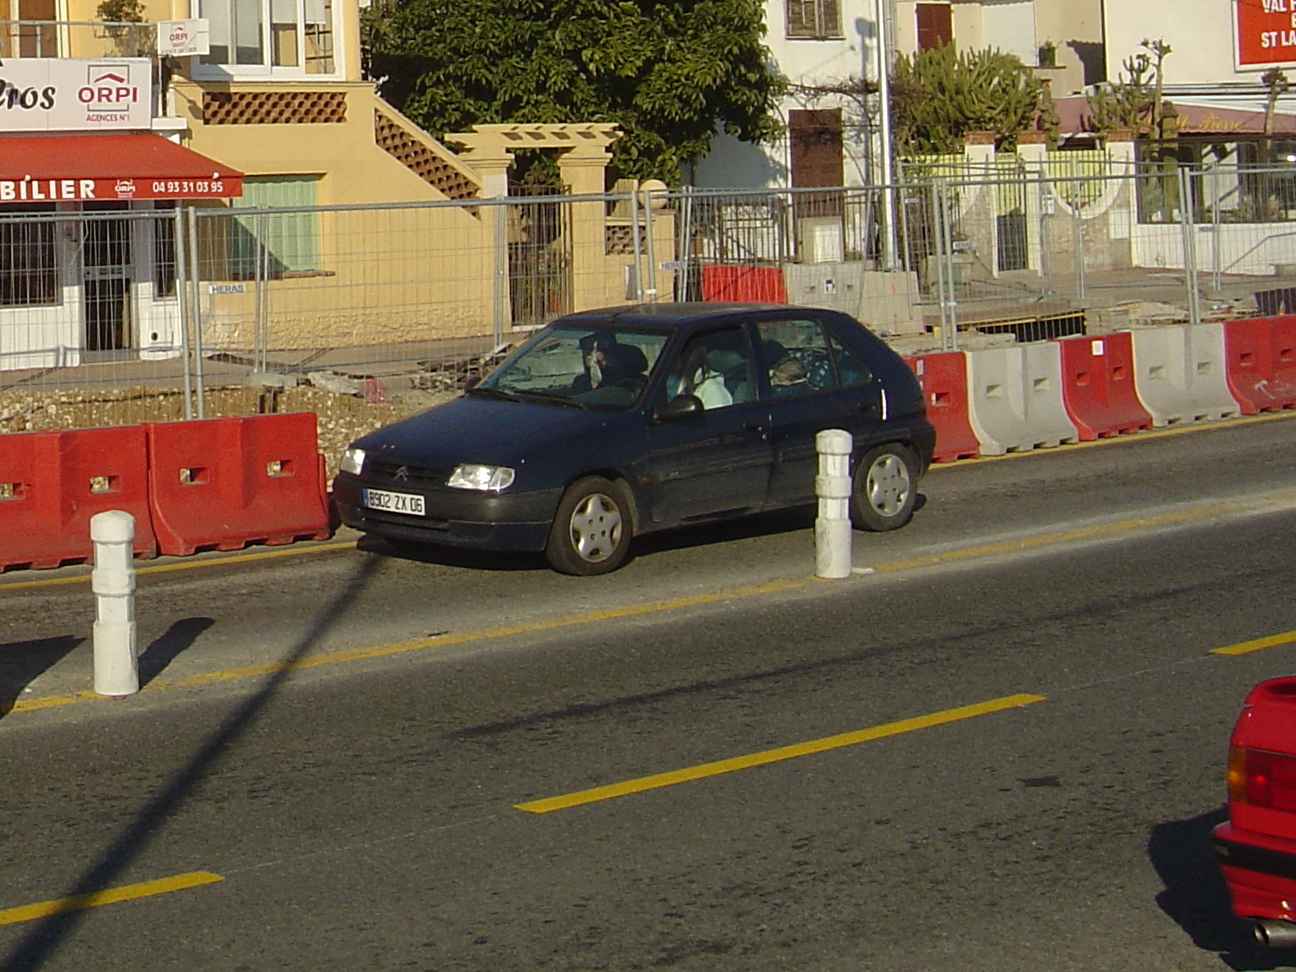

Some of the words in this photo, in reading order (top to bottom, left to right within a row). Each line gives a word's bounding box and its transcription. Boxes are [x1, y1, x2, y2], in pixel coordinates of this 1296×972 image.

[169, 32, 188, 41] ORPI
[1261, 31, 1277, 48] ST
[78, 86, 138, 103] ORPI
[86, 113, 118, 122] AGENCES
[152, 182, 165, 193] 04
[167, 182, 180, 193] 93
[182, 182, 194, 193] 31
[196, 182, 209, 192] 03
[211, 182, 223, 192] 95
[212, 284, 244, 293] HERAS
[394, 495, 408, 511] ZX
[410, 497, 423, 513] 06
